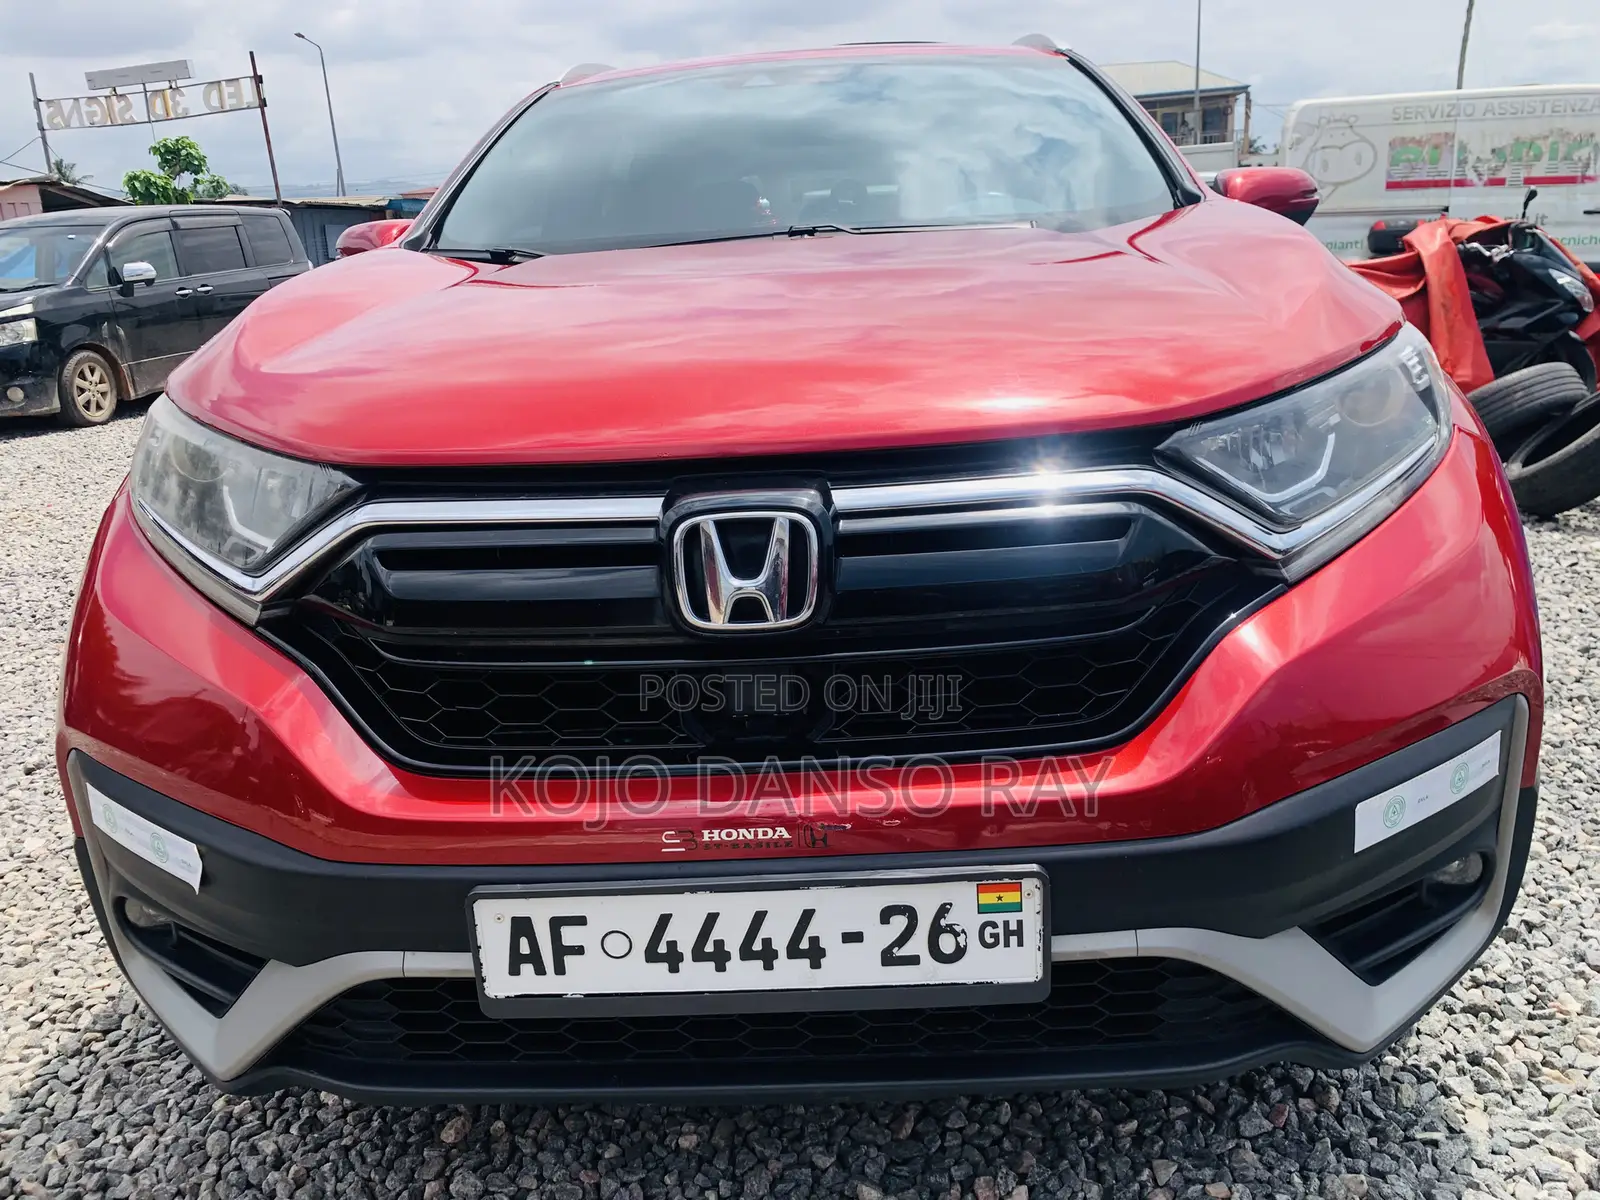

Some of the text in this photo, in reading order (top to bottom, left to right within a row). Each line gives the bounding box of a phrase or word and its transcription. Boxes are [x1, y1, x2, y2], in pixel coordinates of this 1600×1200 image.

[1391, 97, 1600, 122] SERVIZIO ASSISTENZA
[701, 827, 792, 842] HONDA
[508, 915, 588, 977] AF
[977, 919, 1025, 949] GH
